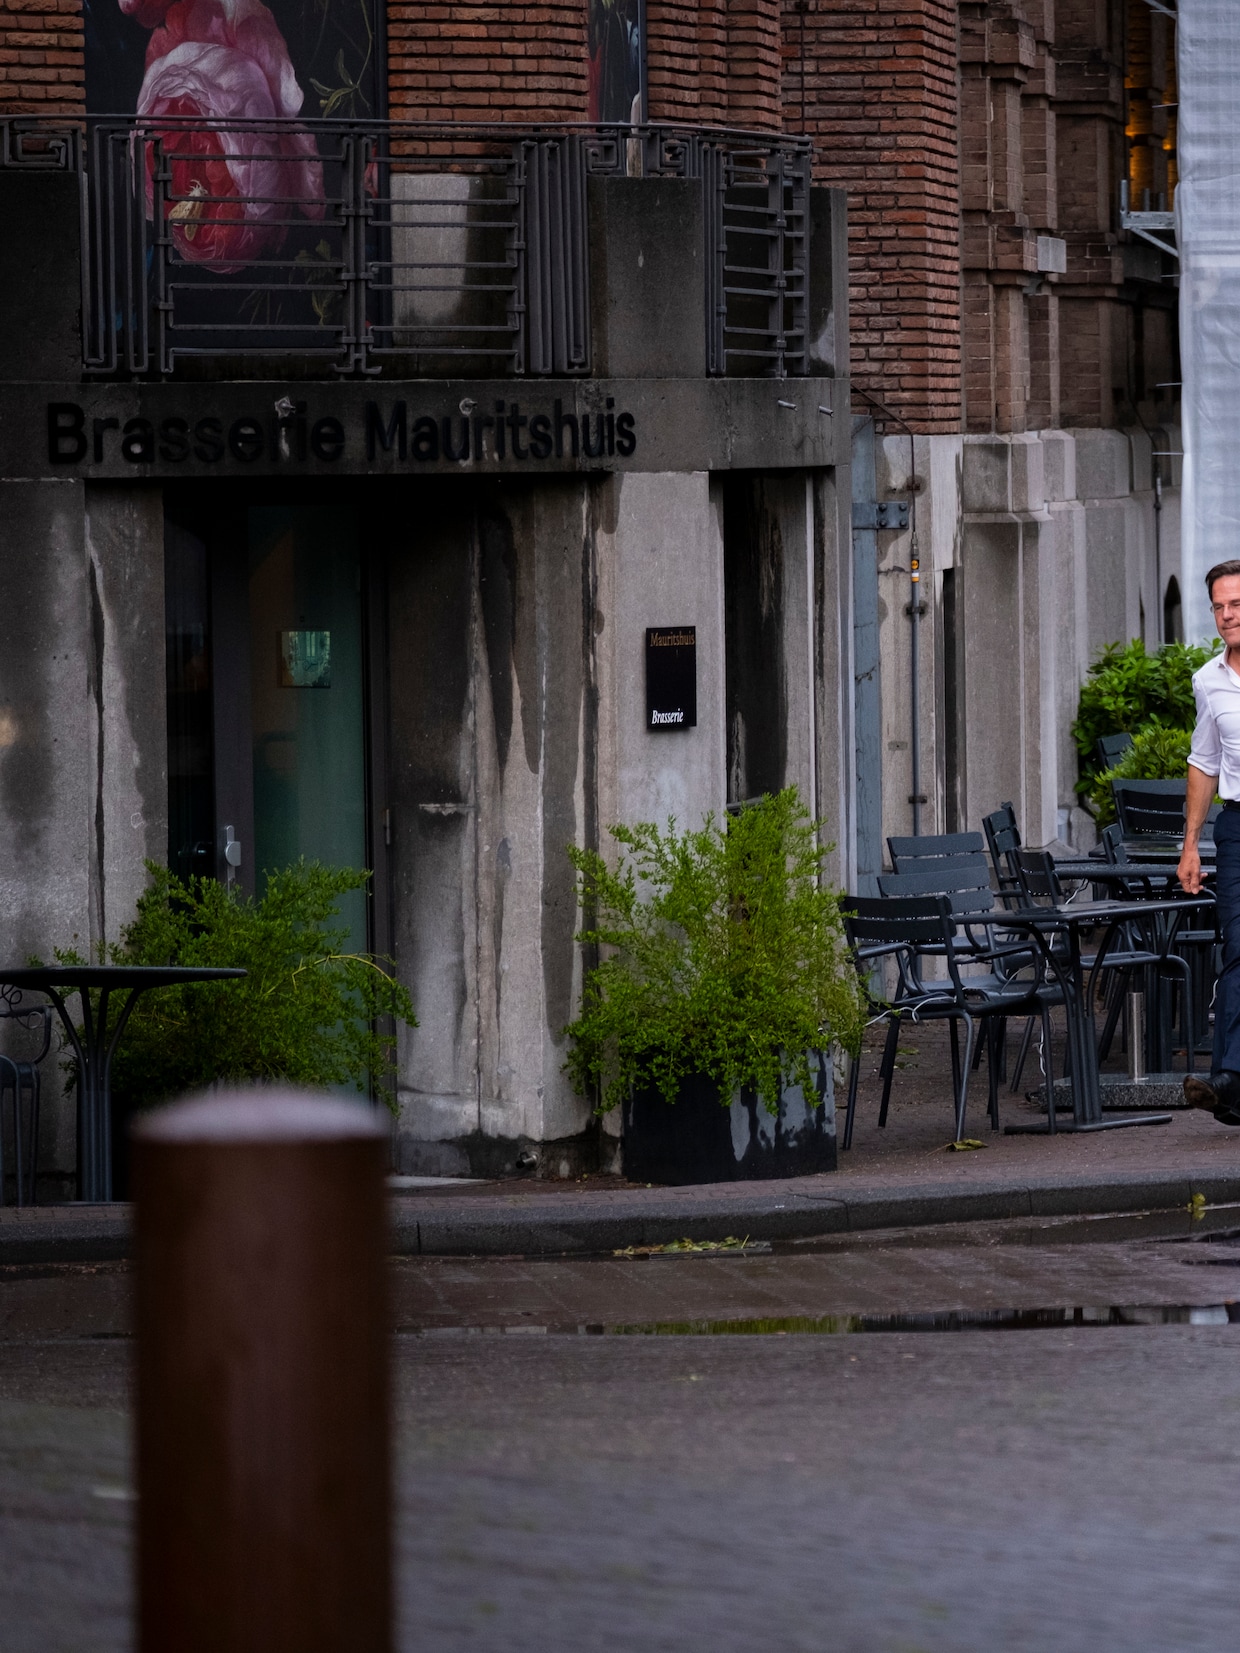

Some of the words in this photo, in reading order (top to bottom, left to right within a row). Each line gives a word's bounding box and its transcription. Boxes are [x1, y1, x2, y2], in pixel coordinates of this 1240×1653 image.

[48, 401, 346, 464] Brasserie
[365, 397, 637, 462] Mauritshuis
[650, 630, 695, 647] Mauritshuis
[651, 707, 684, 725] Brasserie
